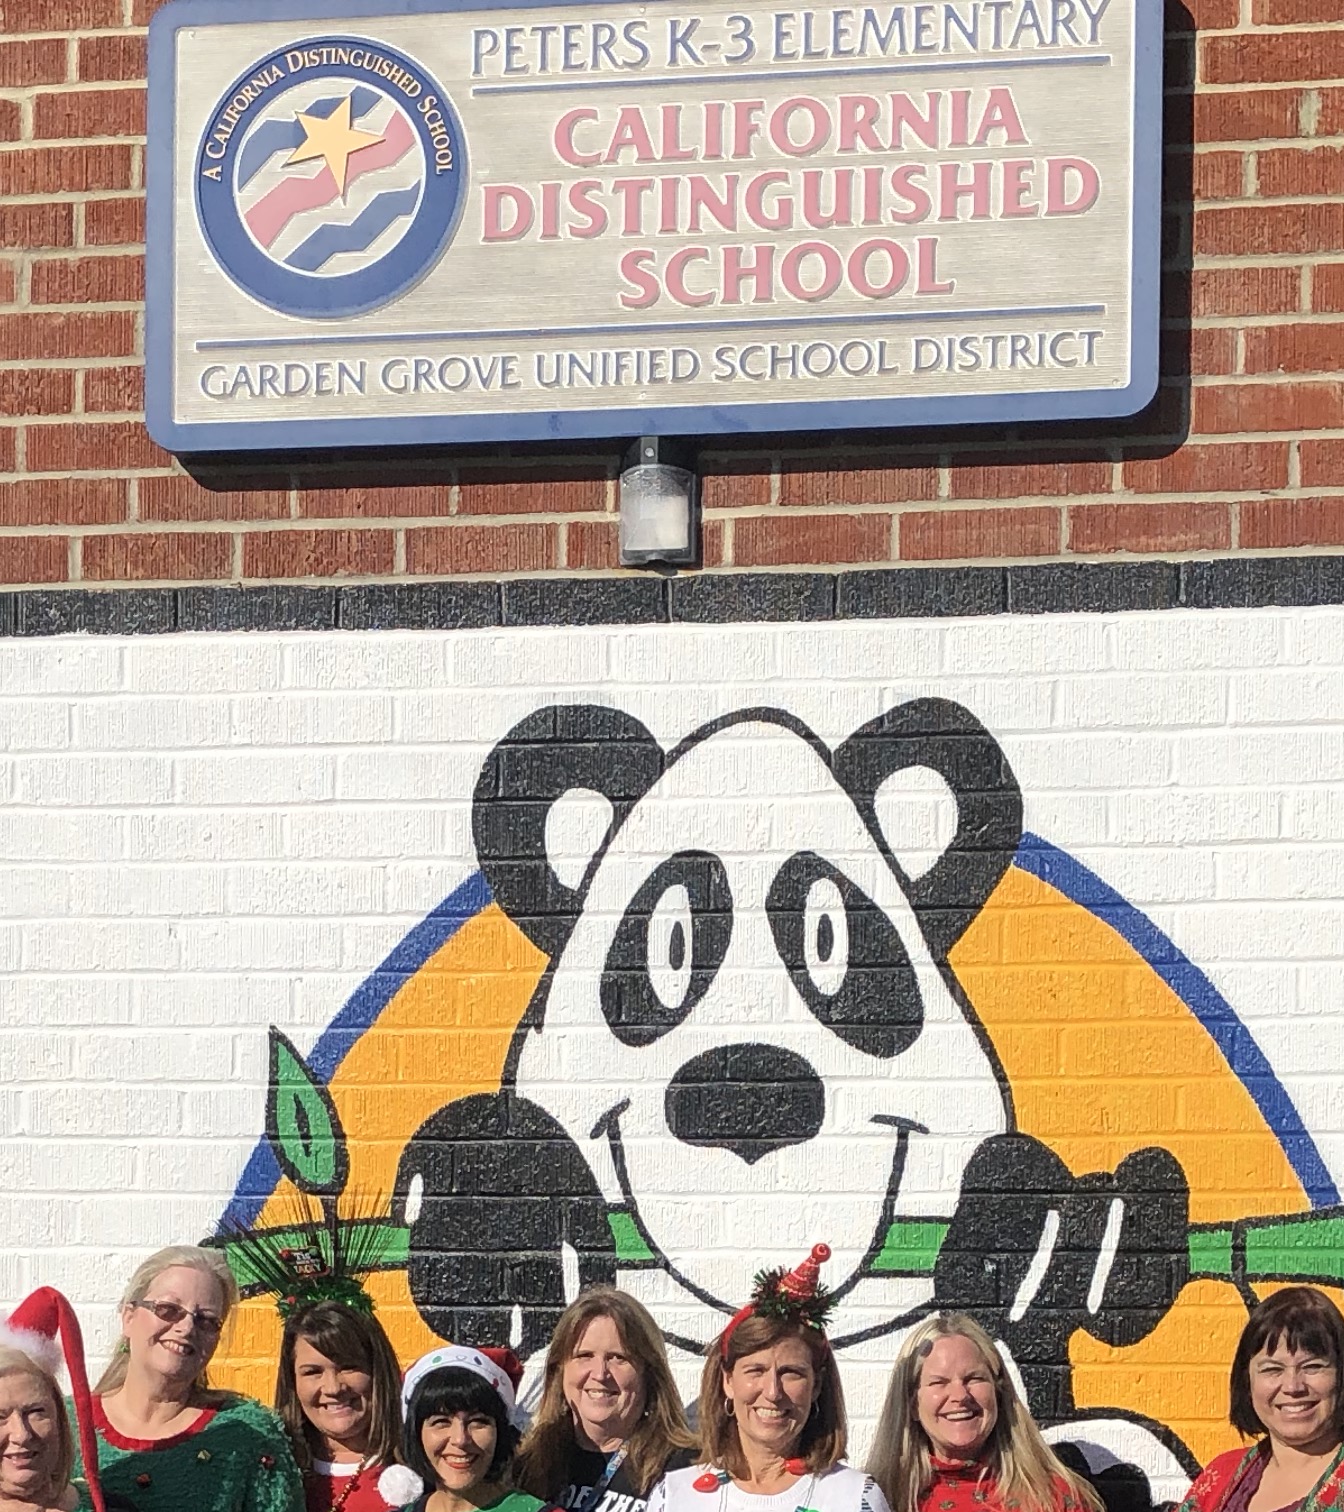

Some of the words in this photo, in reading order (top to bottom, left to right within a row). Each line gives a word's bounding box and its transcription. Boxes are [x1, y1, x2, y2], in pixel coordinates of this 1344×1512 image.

[285, 47, 422, 98] DISTINGUISHED
[471, 19, 649, 77] PETERS
[667, 15, 756, 67] K-3
[771, 0, 1111, 63] ELEMENTARY
[206, 64, 286, 159] CALIFORNIA
[417, 94, 454, 176] SCHOOL
[554, 87, 1032, 167] CALIFORNIA
[202, 165, 223, 182] A
[480, 155, 1101, 244] DISTINGUISHED
[617, 236, 956, 309] SCHOOL
[199, 359, 368, 400] GARDEN
[381, 354, 522, 395] GROVE
[535, 347, 702, 389] UNIFIED
[713, 339, 899, 381] SCHOOL
[911, 330, 1105, 372] DISTRICT
